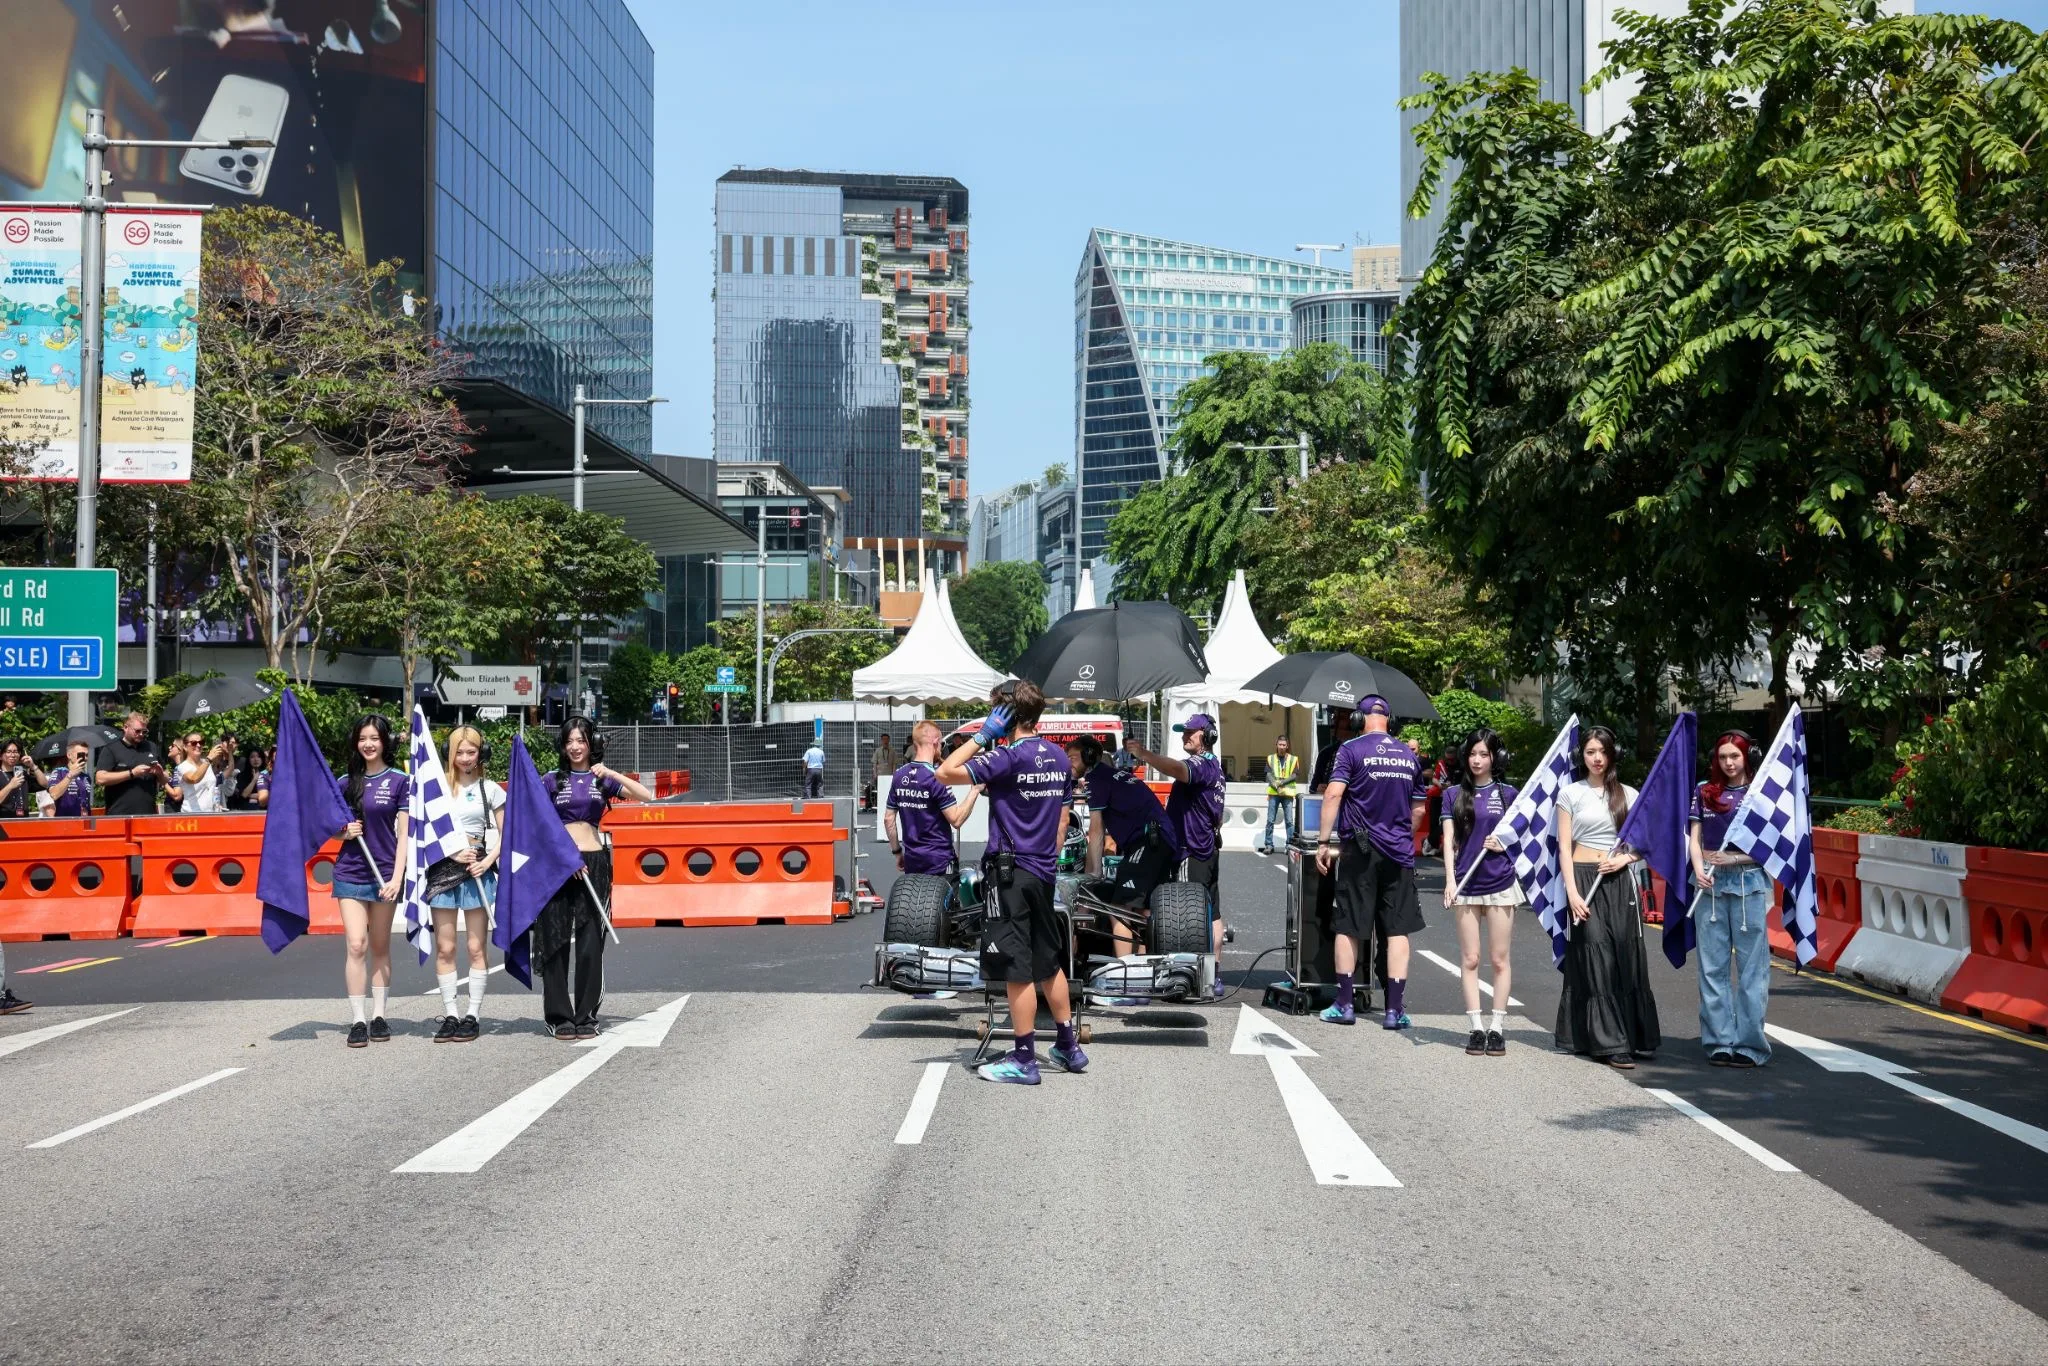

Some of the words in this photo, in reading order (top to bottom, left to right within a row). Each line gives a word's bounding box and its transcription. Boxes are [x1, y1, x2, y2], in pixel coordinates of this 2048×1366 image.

[8, 225, 27, 236] SG
[128, 227, 147, 238] SG
[131, 271, 174, 279] SUMMER
[4, 277, 64, 285] ADVENTURE
[122, 279, 182, 287] ADVENTURE
[24, 579, 47, 598] Rd
[22, 607, 44, 627] Rd
[478, 675, 511, 683] Elizabeth
[467, 688, 496, 697] Hospital
[1041, 722, 1093, 730] AMBULANCE
